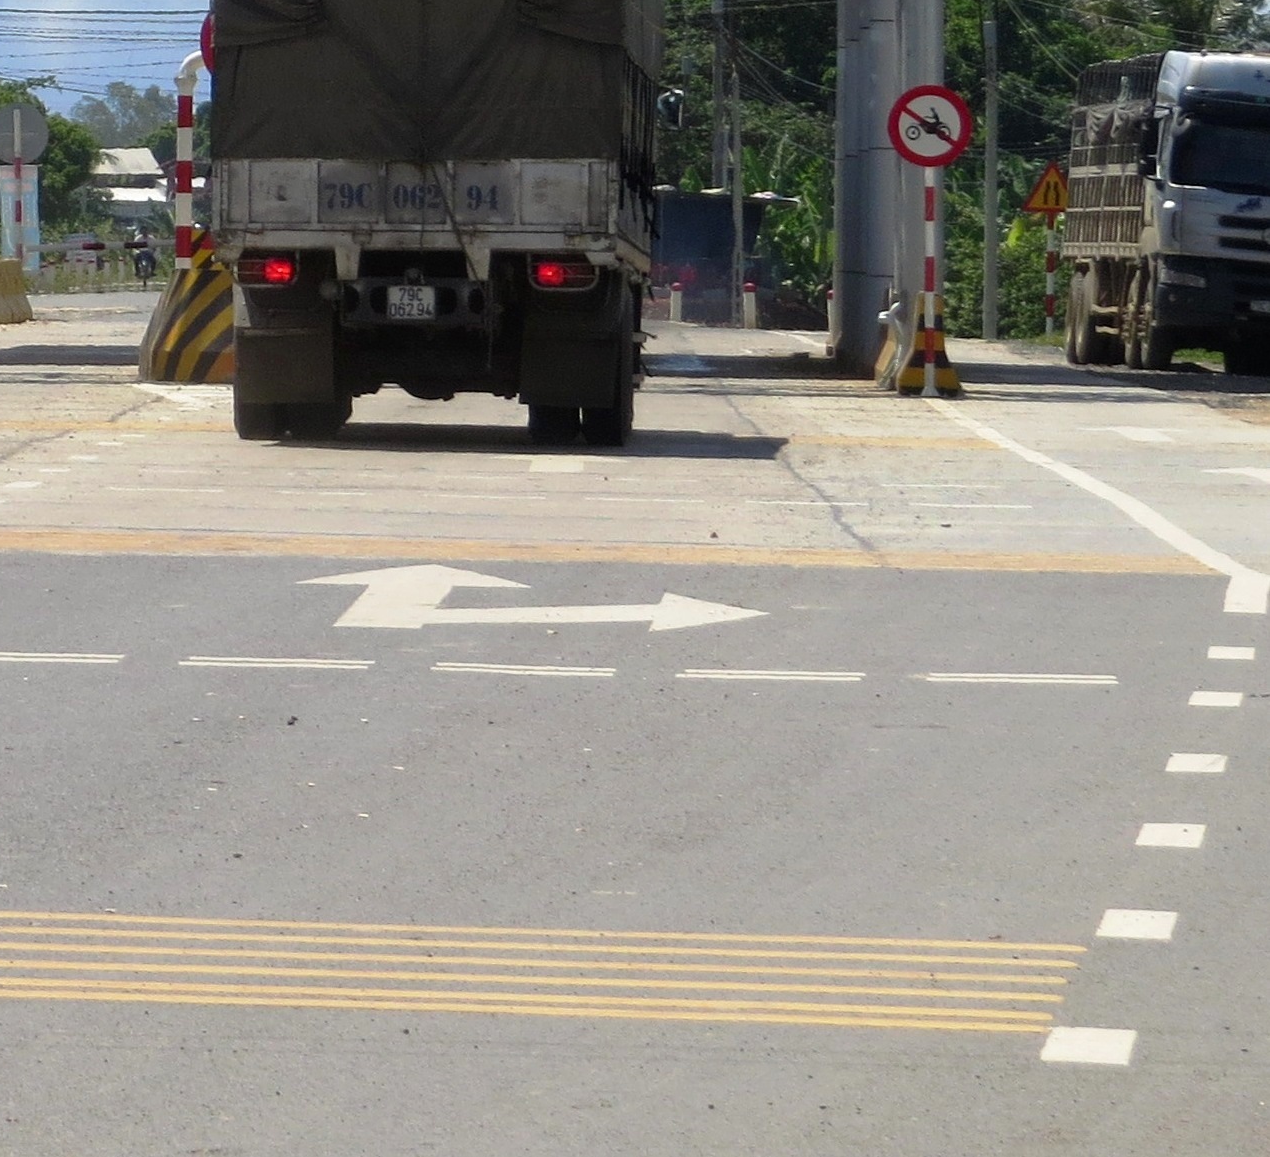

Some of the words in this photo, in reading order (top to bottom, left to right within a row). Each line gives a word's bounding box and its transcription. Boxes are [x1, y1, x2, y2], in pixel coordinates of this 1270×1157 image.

[324, 182, 372, 210] 79C
[392, 183, 444, 210] 062
[465, 184, 499, 211] 94
[399, 287, 423, 301] 79C
